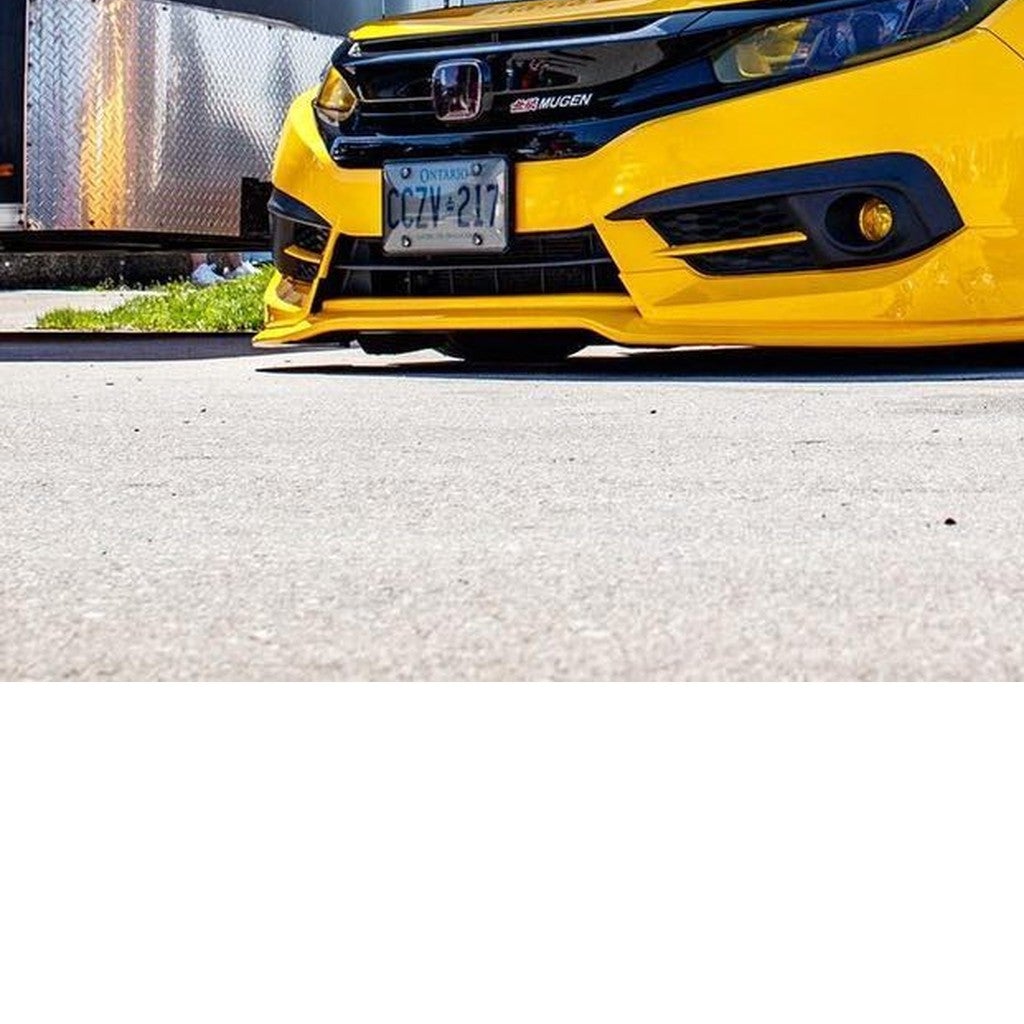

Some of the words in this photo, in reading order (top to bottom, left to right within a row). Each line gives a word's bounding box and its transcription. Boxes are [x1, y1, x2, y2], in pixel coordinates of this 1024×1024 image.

[539, 93, 593, 110] MUGEN
[420, 167, 468, 183] ONTARIO
[457, 183, 499, 228] 217
